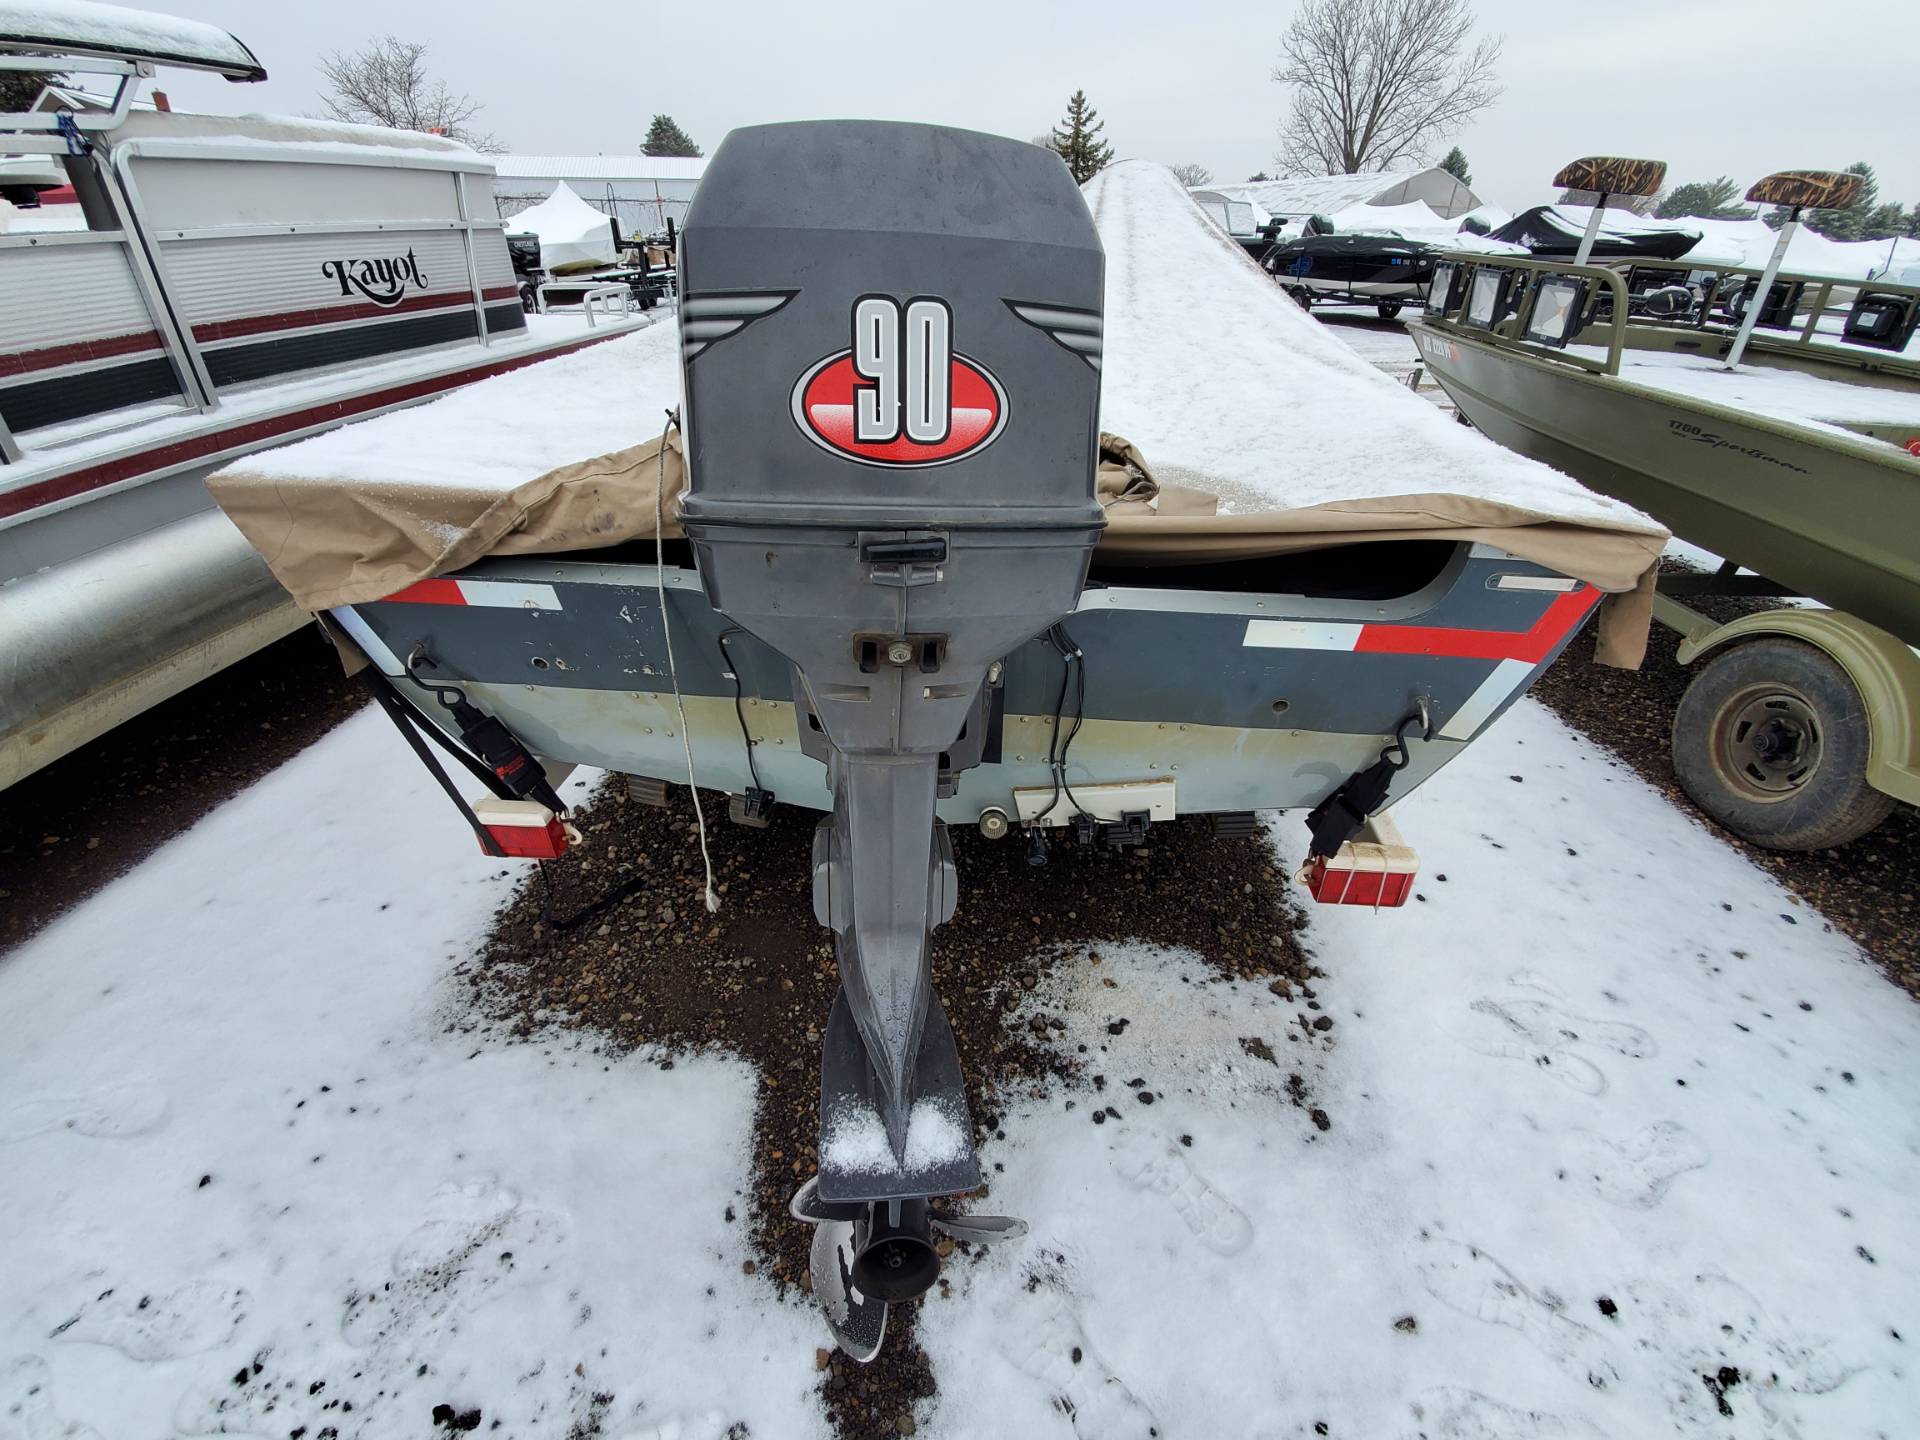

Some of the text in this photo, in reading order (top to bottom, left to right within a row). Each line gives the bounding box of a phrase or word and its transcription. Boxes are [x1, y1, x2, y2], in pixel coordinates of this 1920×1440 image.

[322, 246, 428, 304] Kayot
[851, 294, 953, 445] 90
[1691, 433, 1808, 474] Sportsman
